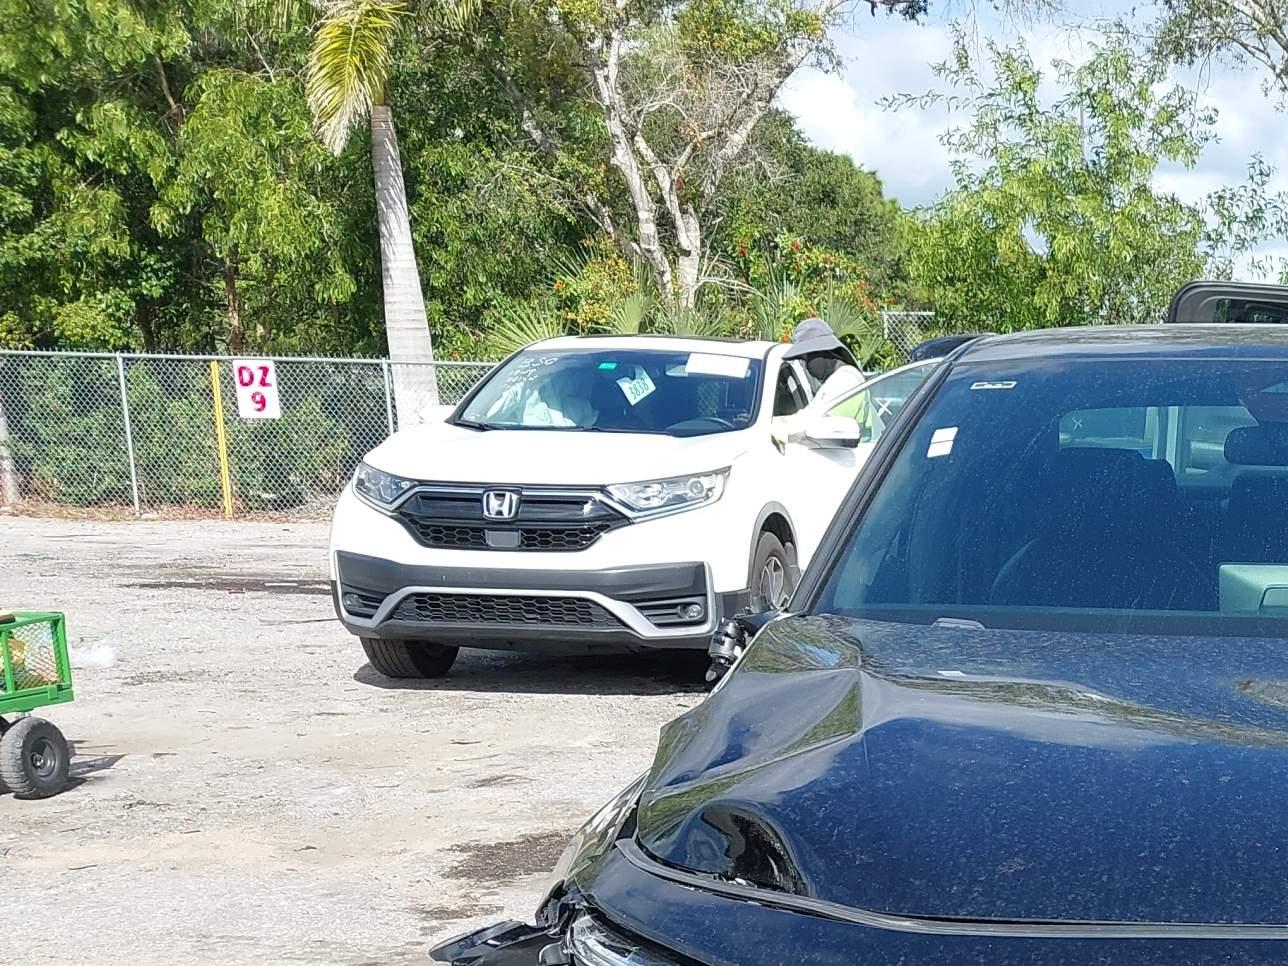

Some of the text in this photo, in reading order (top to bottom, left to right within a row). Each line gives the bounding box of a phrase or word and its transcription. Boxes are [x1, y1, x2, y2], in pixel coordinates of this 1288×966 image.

[237, 366, 272, 387] DZ
[628, 377, 650, 400] 3838
[251, 391, 267, 413] 9
